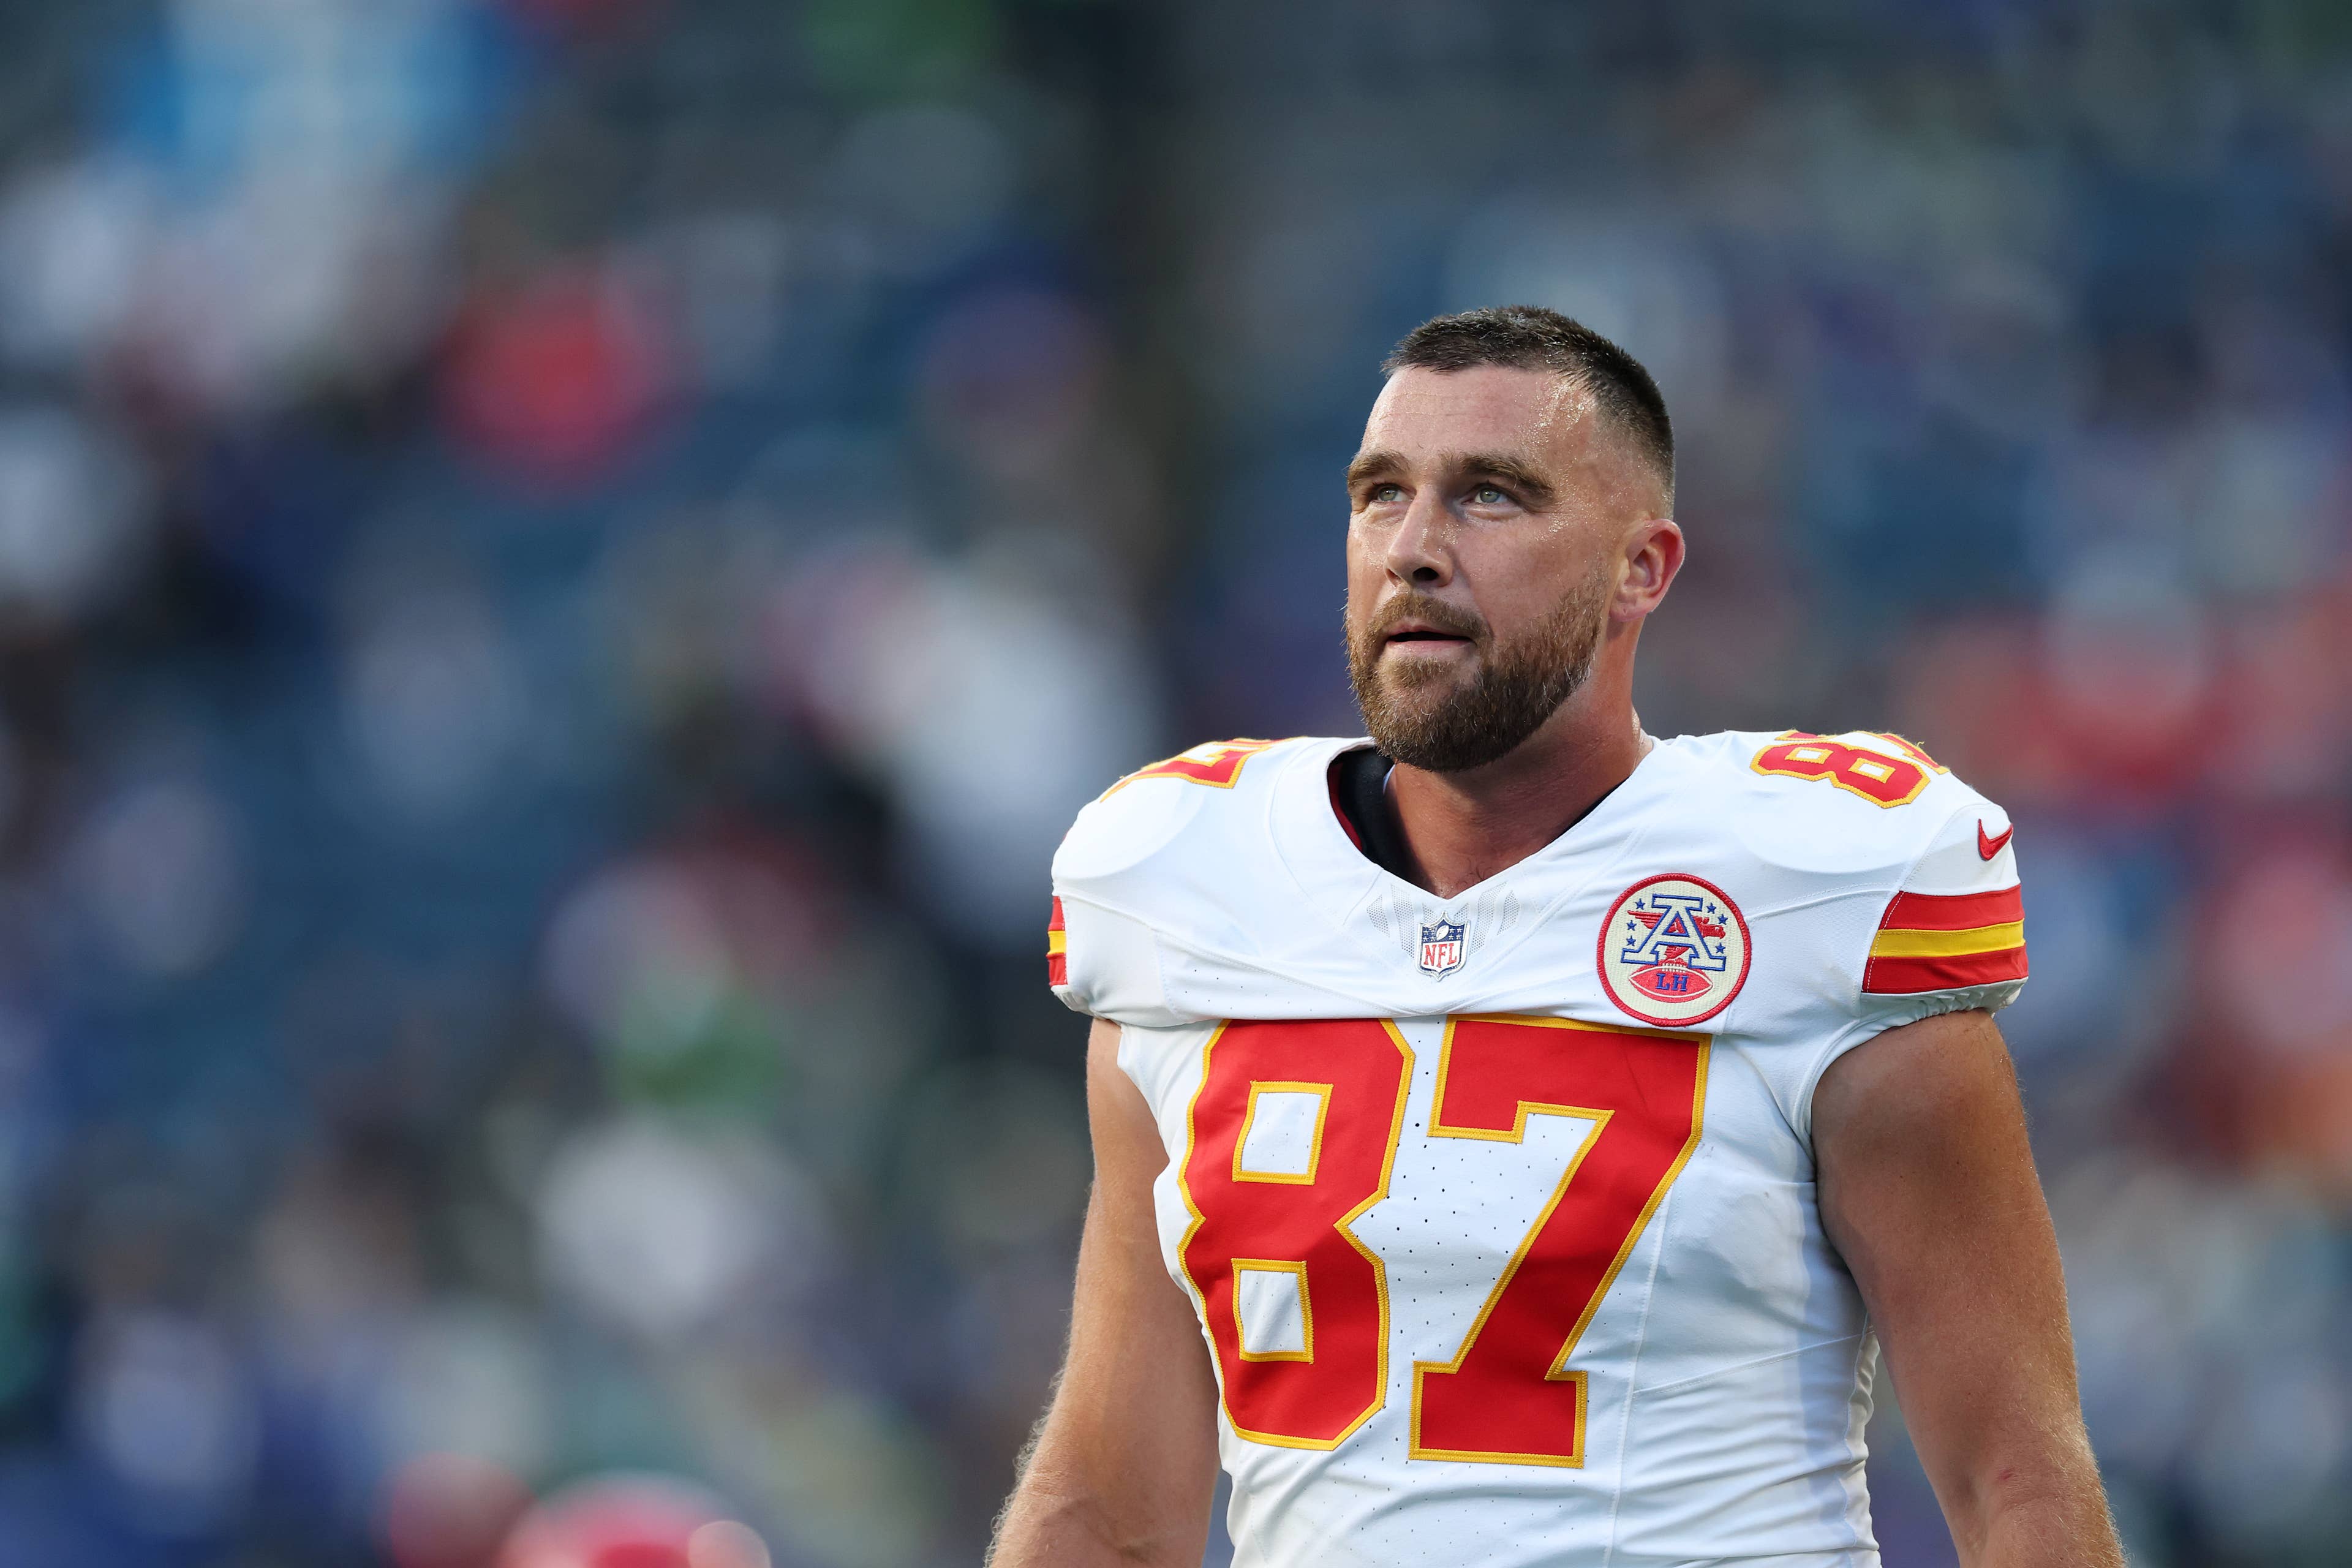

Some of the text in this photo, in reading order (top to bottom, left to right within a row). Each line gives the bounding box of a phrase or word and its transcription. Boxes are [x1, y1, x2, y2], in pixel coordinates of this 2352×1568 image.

[1099, 736, 1305, 803] 7
[1750, 729, 1950, 809] 8
[1423, 943, 1457, 968] NFL
[1621, 894, 1726, 971] A
[1656, 973, 1689, 991] LH
[1177, 1014, 1711, 1469] 87
